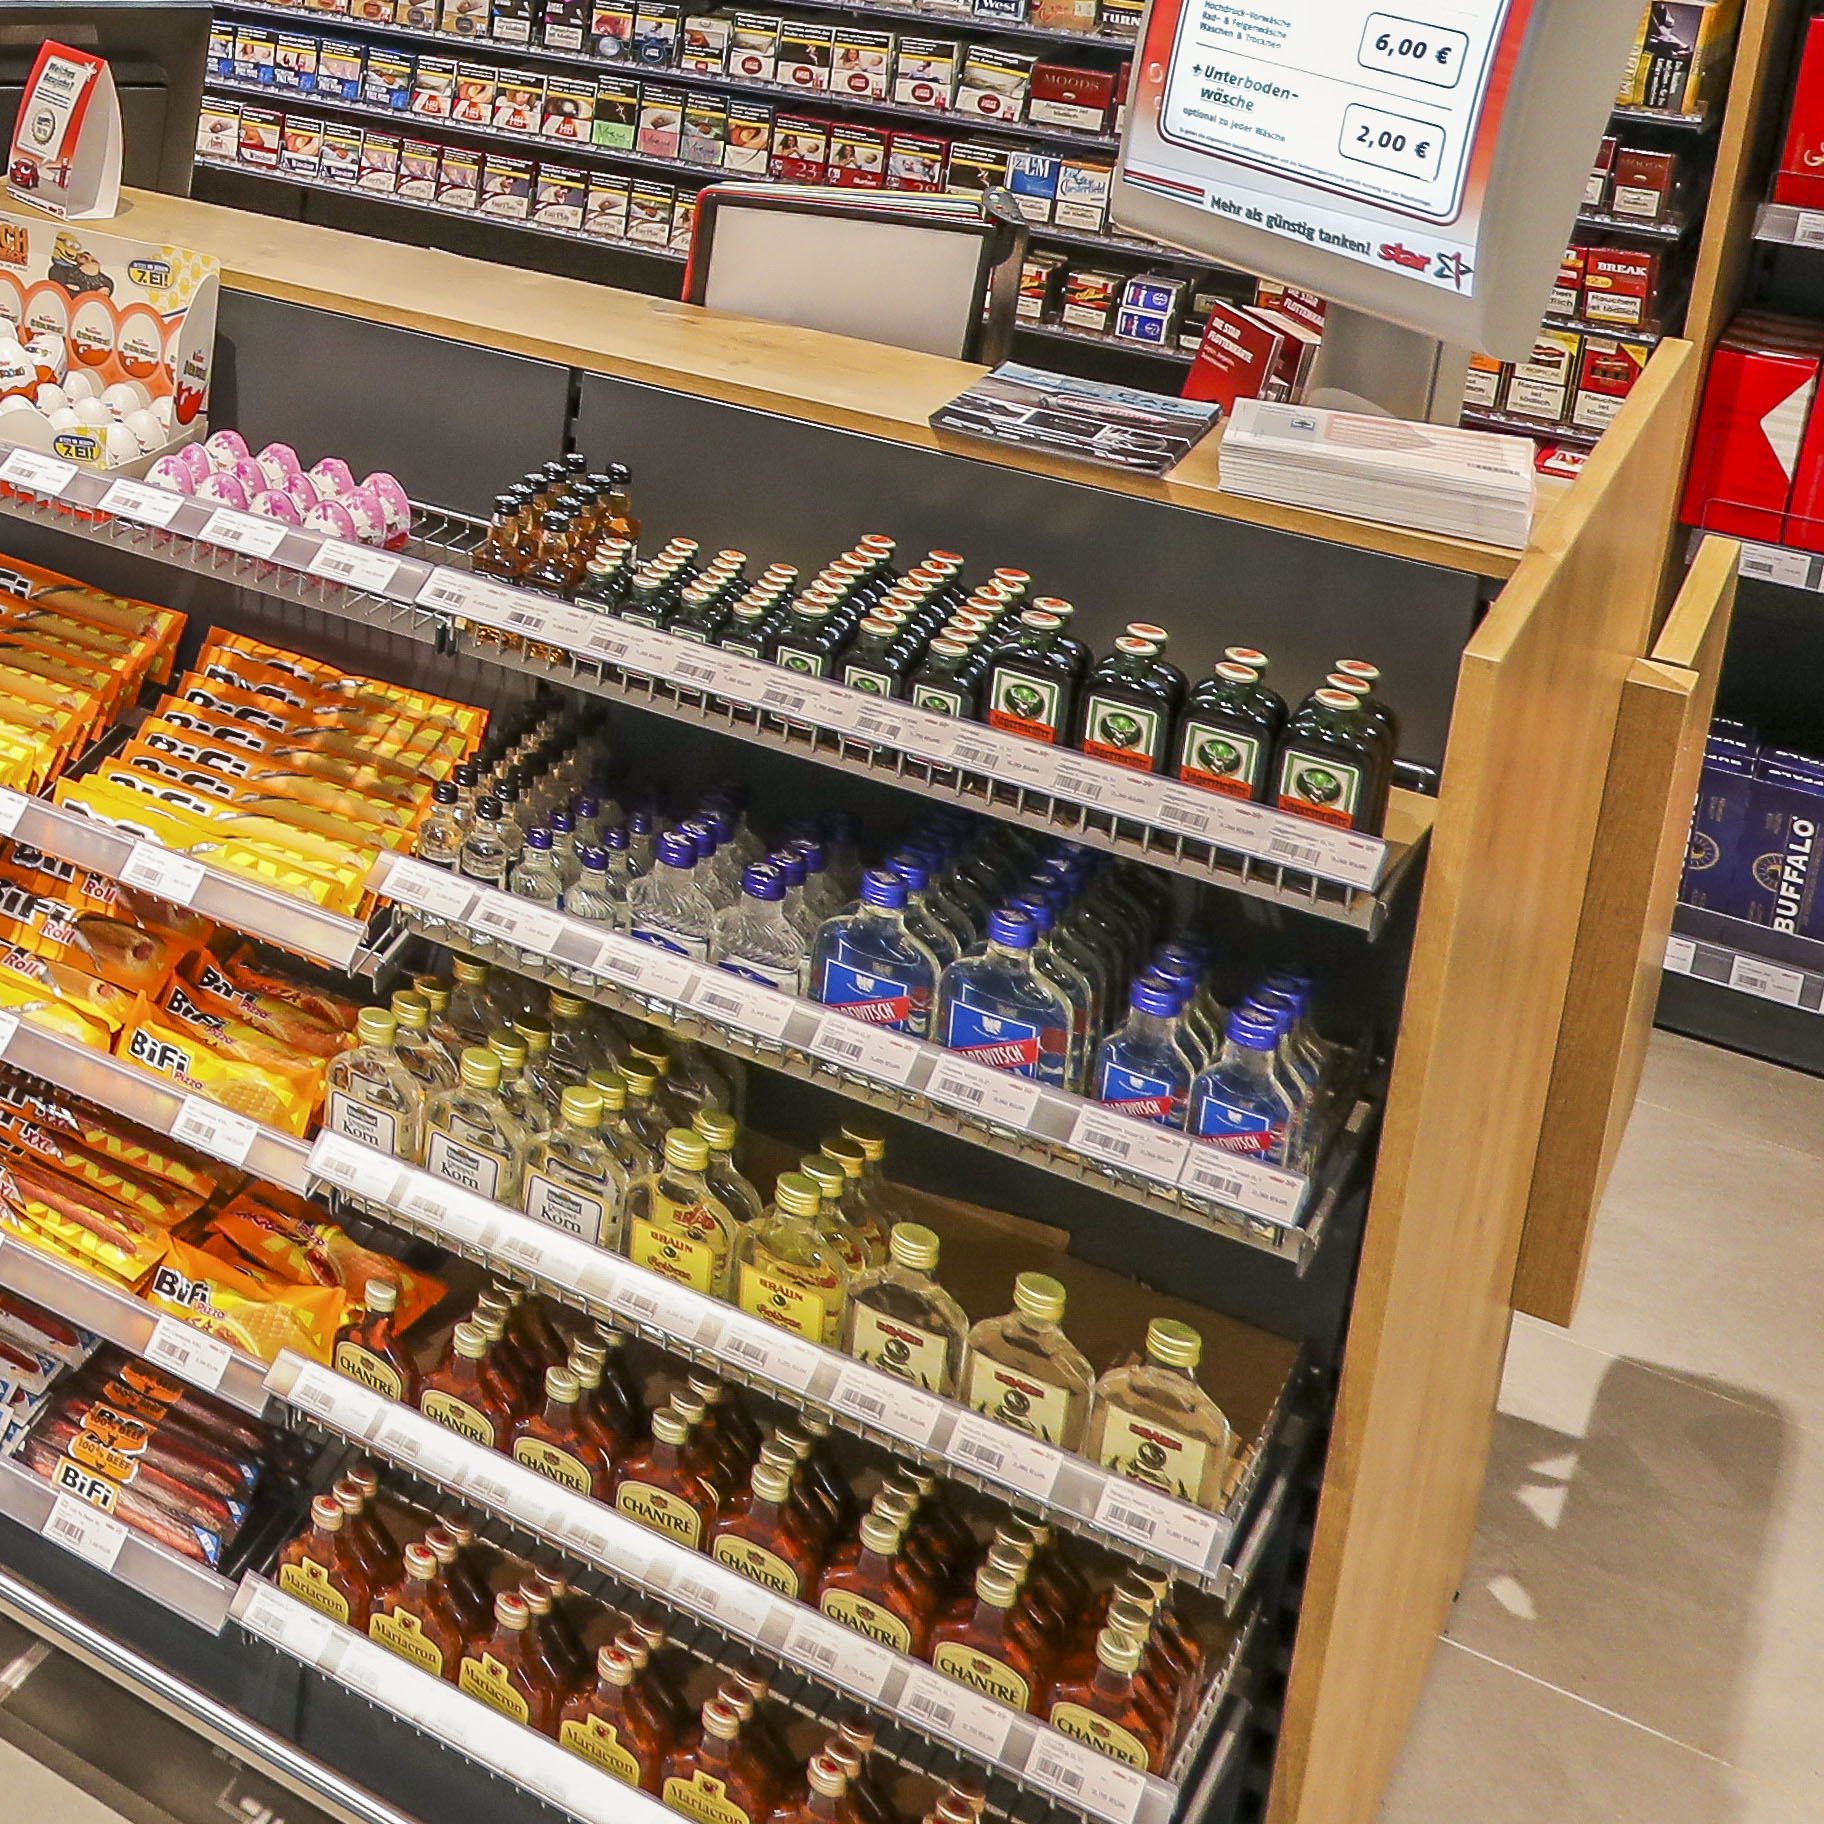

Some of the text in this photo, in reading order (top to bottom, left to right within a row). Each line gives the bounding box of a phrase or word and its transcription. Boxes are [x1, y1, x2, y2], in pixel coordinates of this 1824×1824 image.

[1375, 32, 1428, 60] 6,00
[1435, 45, 1452, 66] €
[1042, 75, 1101, 92] MOODS
[1204, 65, 1299, 101] Unterboden-
[1200, 86, 1431, 159] wäsche 2,00 €
[1211, 194, 1431, 272] Mehr als günstig tanken! star
[1597, 262, 1647, 276] BREAK
[81, 877, 117, 905] Roll
[1772, 815, 1816, 935] BUFFALO
[130, 1028, 192, 1074] BiFi
[344, 1127, 381, 1149] Korn
[441, 1162, 480, 1191] Korn
[152, 1268, 213, 1310] BiFi
[338, 1354, 396, 1399] CHANTRÉ
[60, 1464, 115, 1508] BiFi
[283, 1572, 346, 1615] Mariacron
[373, 1618, 440, 1662] Mariacron
[826, 1604, 901, 1647] CHANTRÉ
[940, 1656, 1019, 1702] CHANTRÉ
